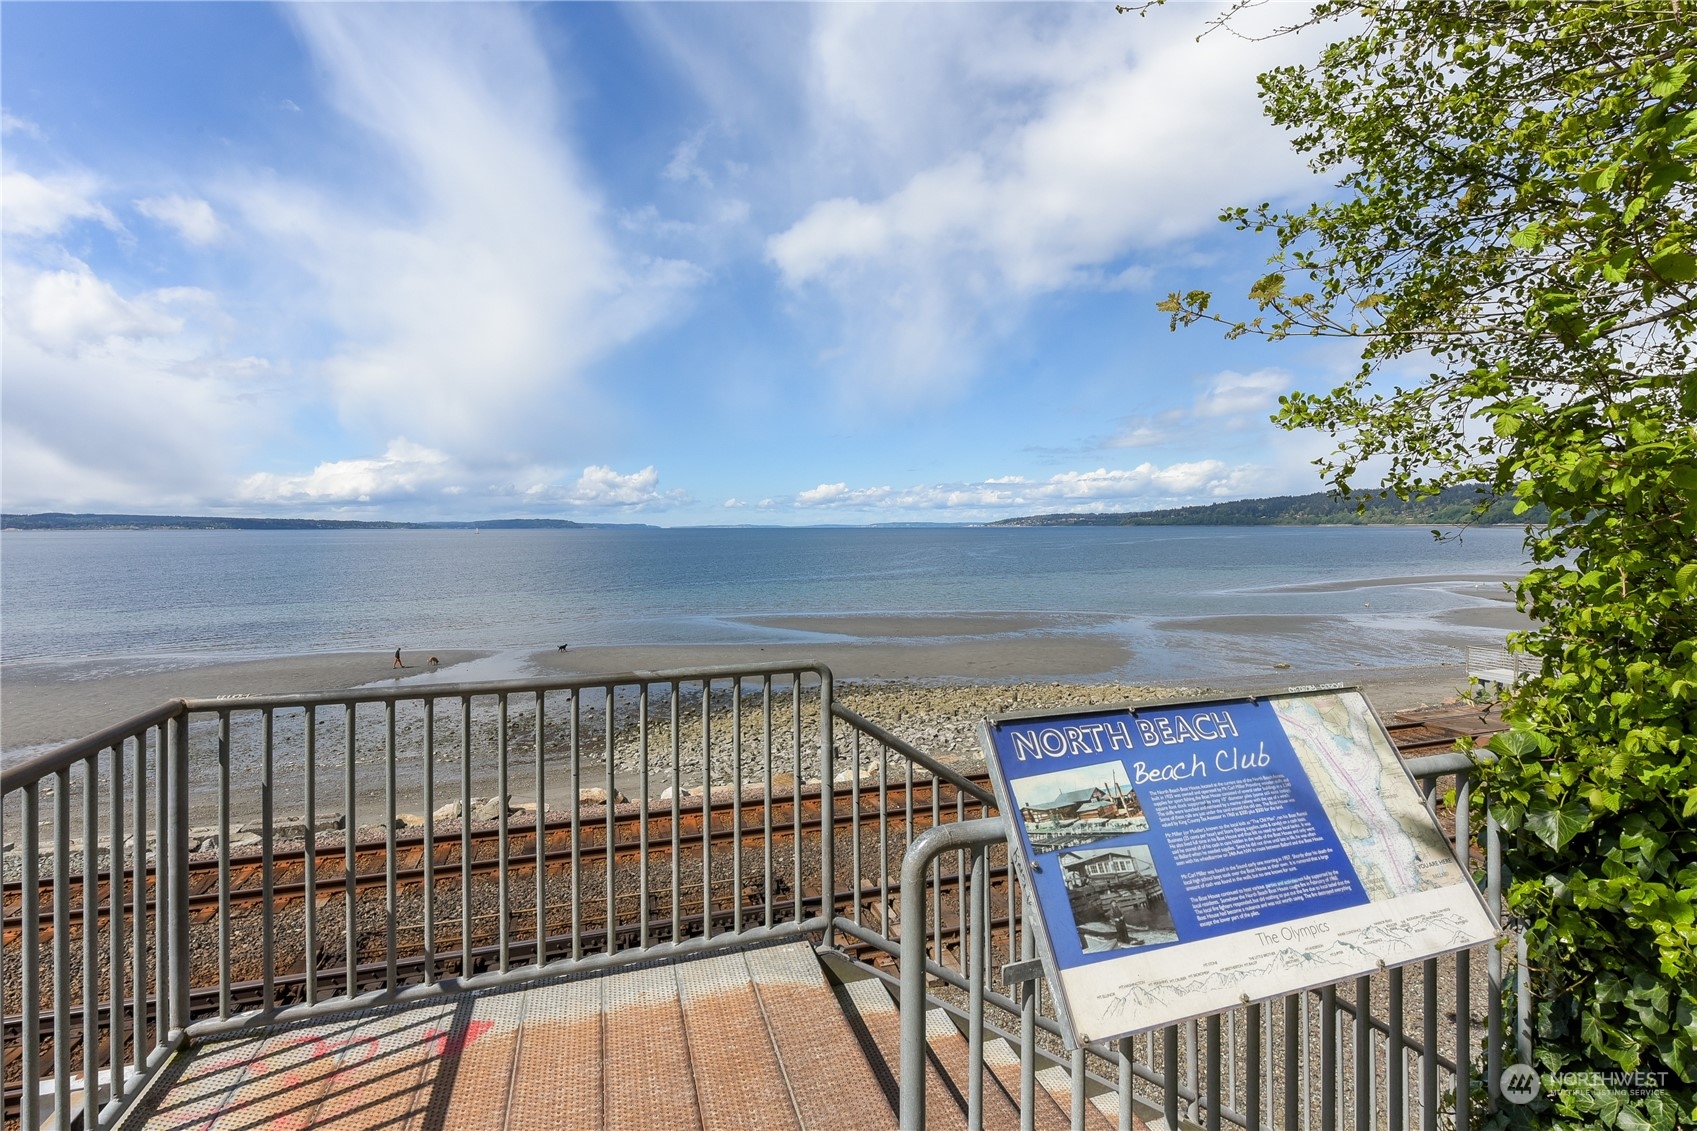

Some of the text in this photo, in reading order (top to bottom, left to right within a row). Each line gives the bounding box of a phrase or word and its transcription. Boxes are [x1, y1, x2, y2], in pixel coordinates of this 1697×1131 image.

[1010, 711, 1240, 761] NORTH BEACH
[1134, 741, 1272, 784] Beach Club
[1254, 930, 1280, 947] The
[1280, 922, 1330, 945] Olympics
